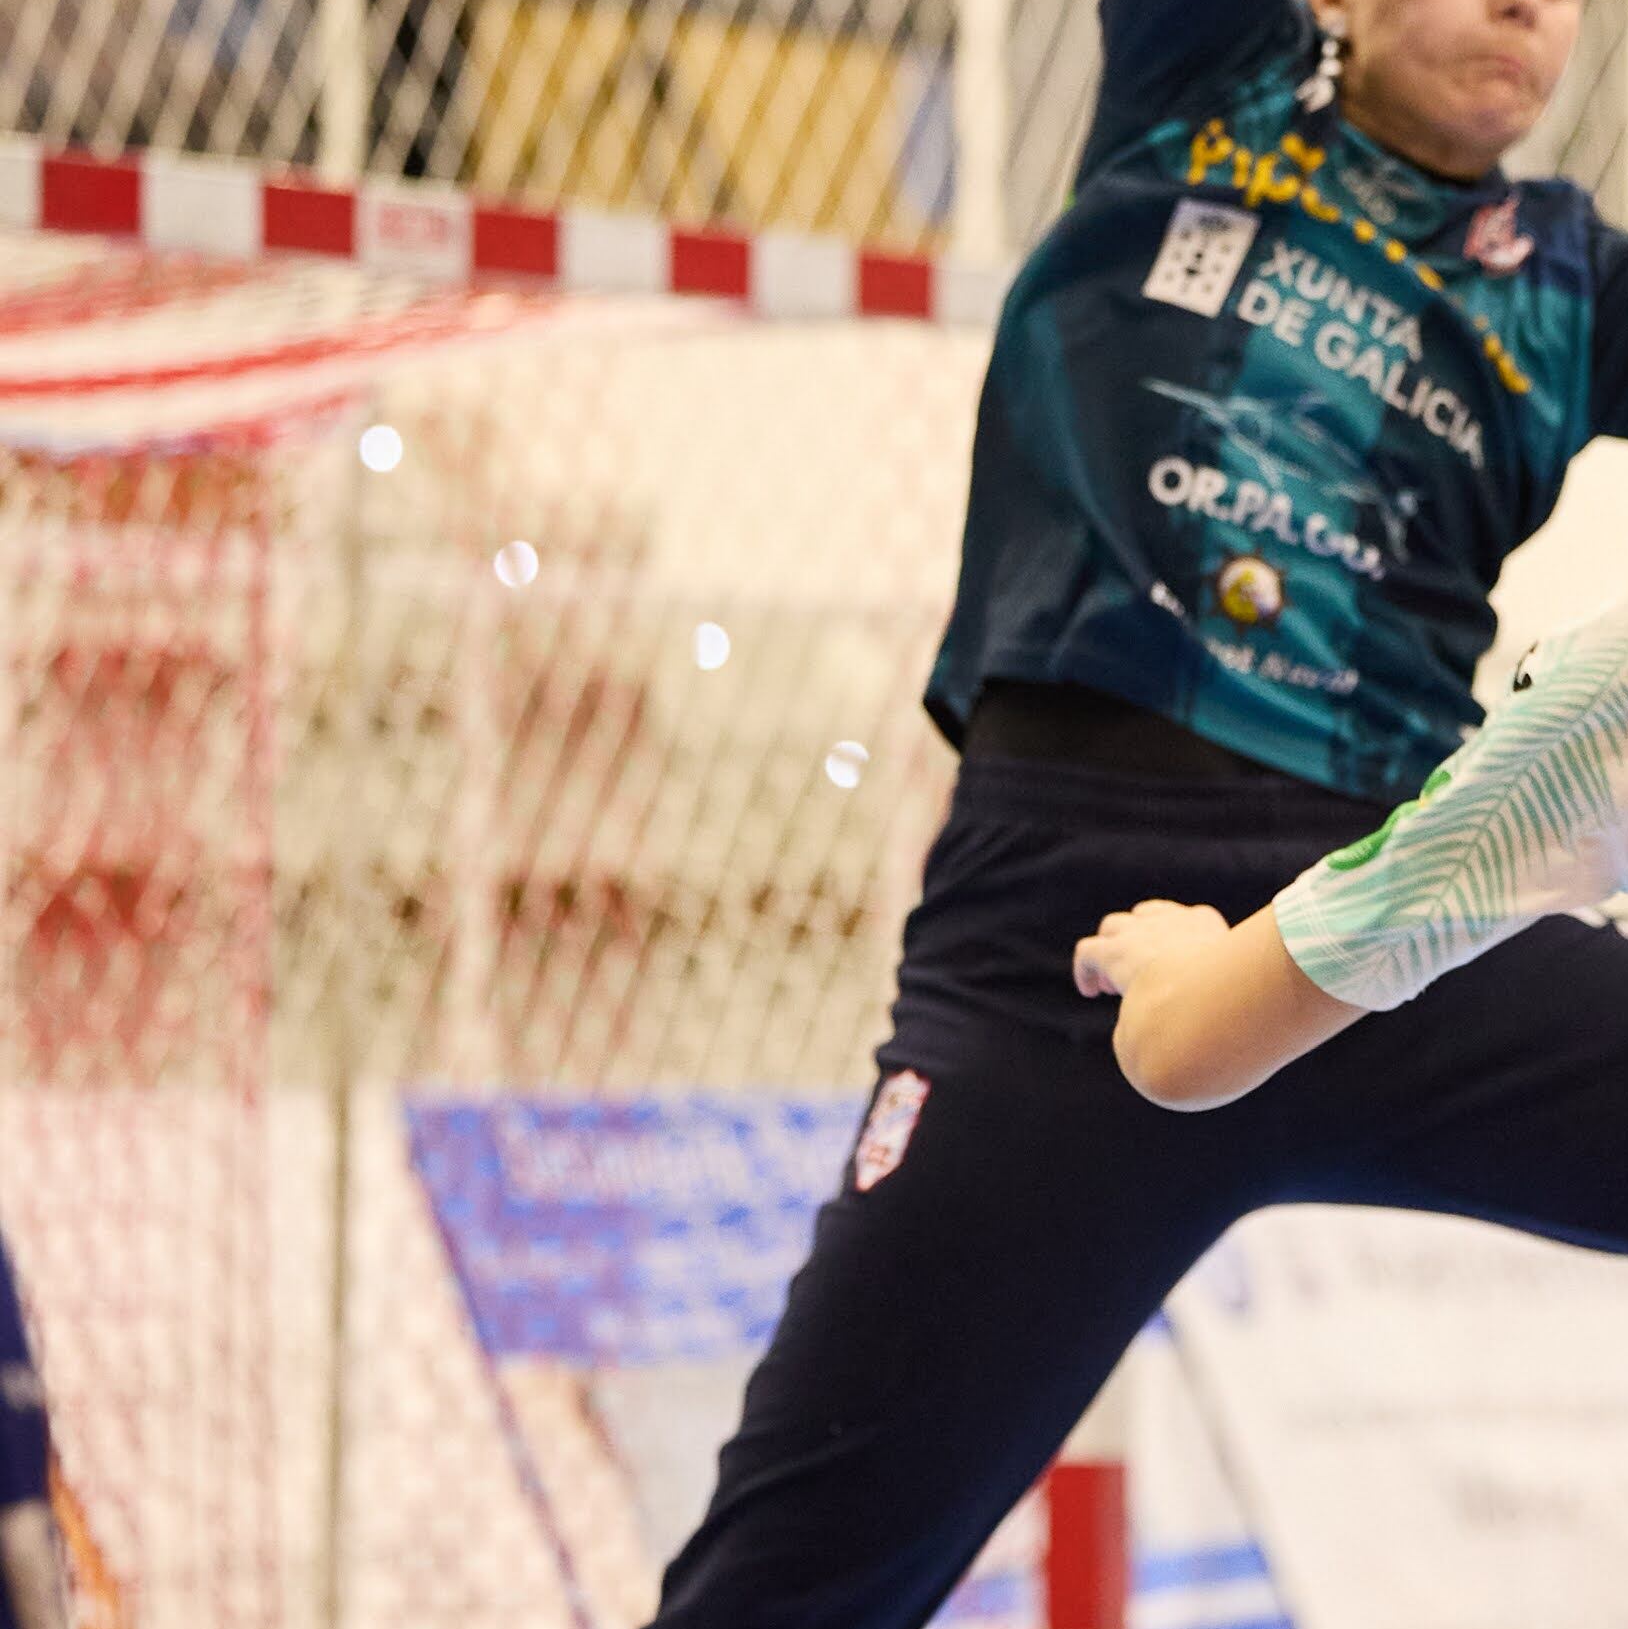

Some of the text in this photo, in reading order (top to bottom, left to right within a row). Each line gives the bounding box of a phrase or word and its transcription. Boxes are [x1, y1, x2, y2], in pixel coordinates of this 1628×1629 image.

[1237, 281, 1315, 347] DE
[1314, 320, 1485, 469] GALICIA
[1259, 240, 1423, 363] XUNTA
